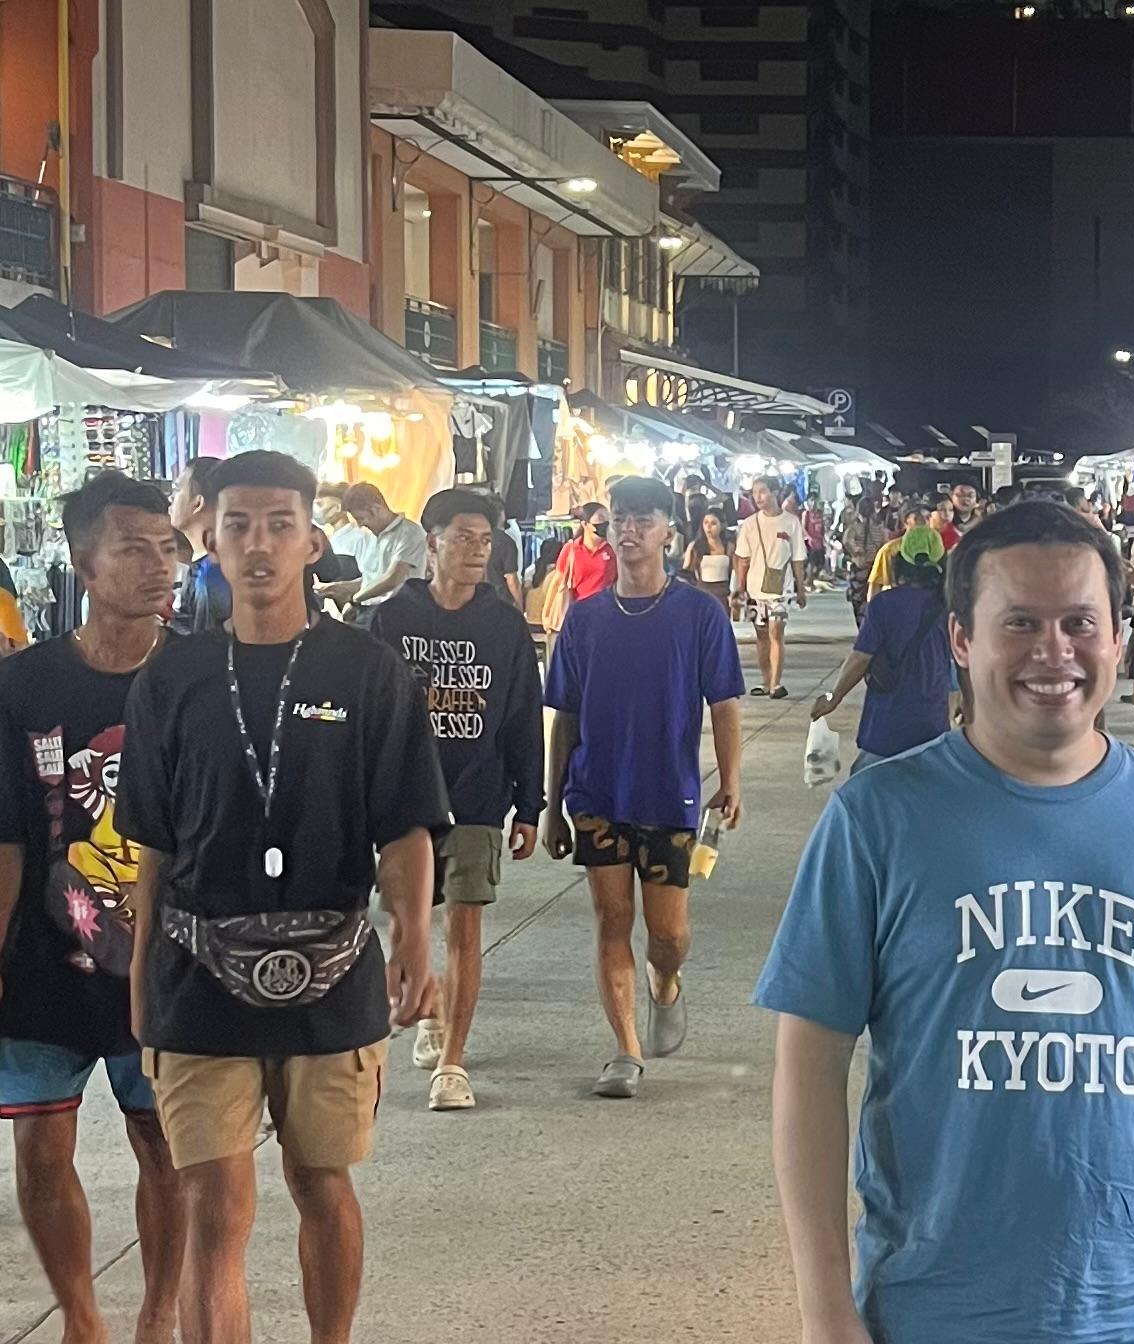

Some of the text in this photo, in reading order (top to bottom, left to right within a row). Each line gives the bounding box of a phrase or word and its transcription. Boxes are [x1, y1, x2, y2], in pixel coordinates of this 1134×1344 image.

[402, 635, 476, 665] STRESSED
[431, 664, 492, 690] BLESSED
[429, 711, 484, 739] SESSED
